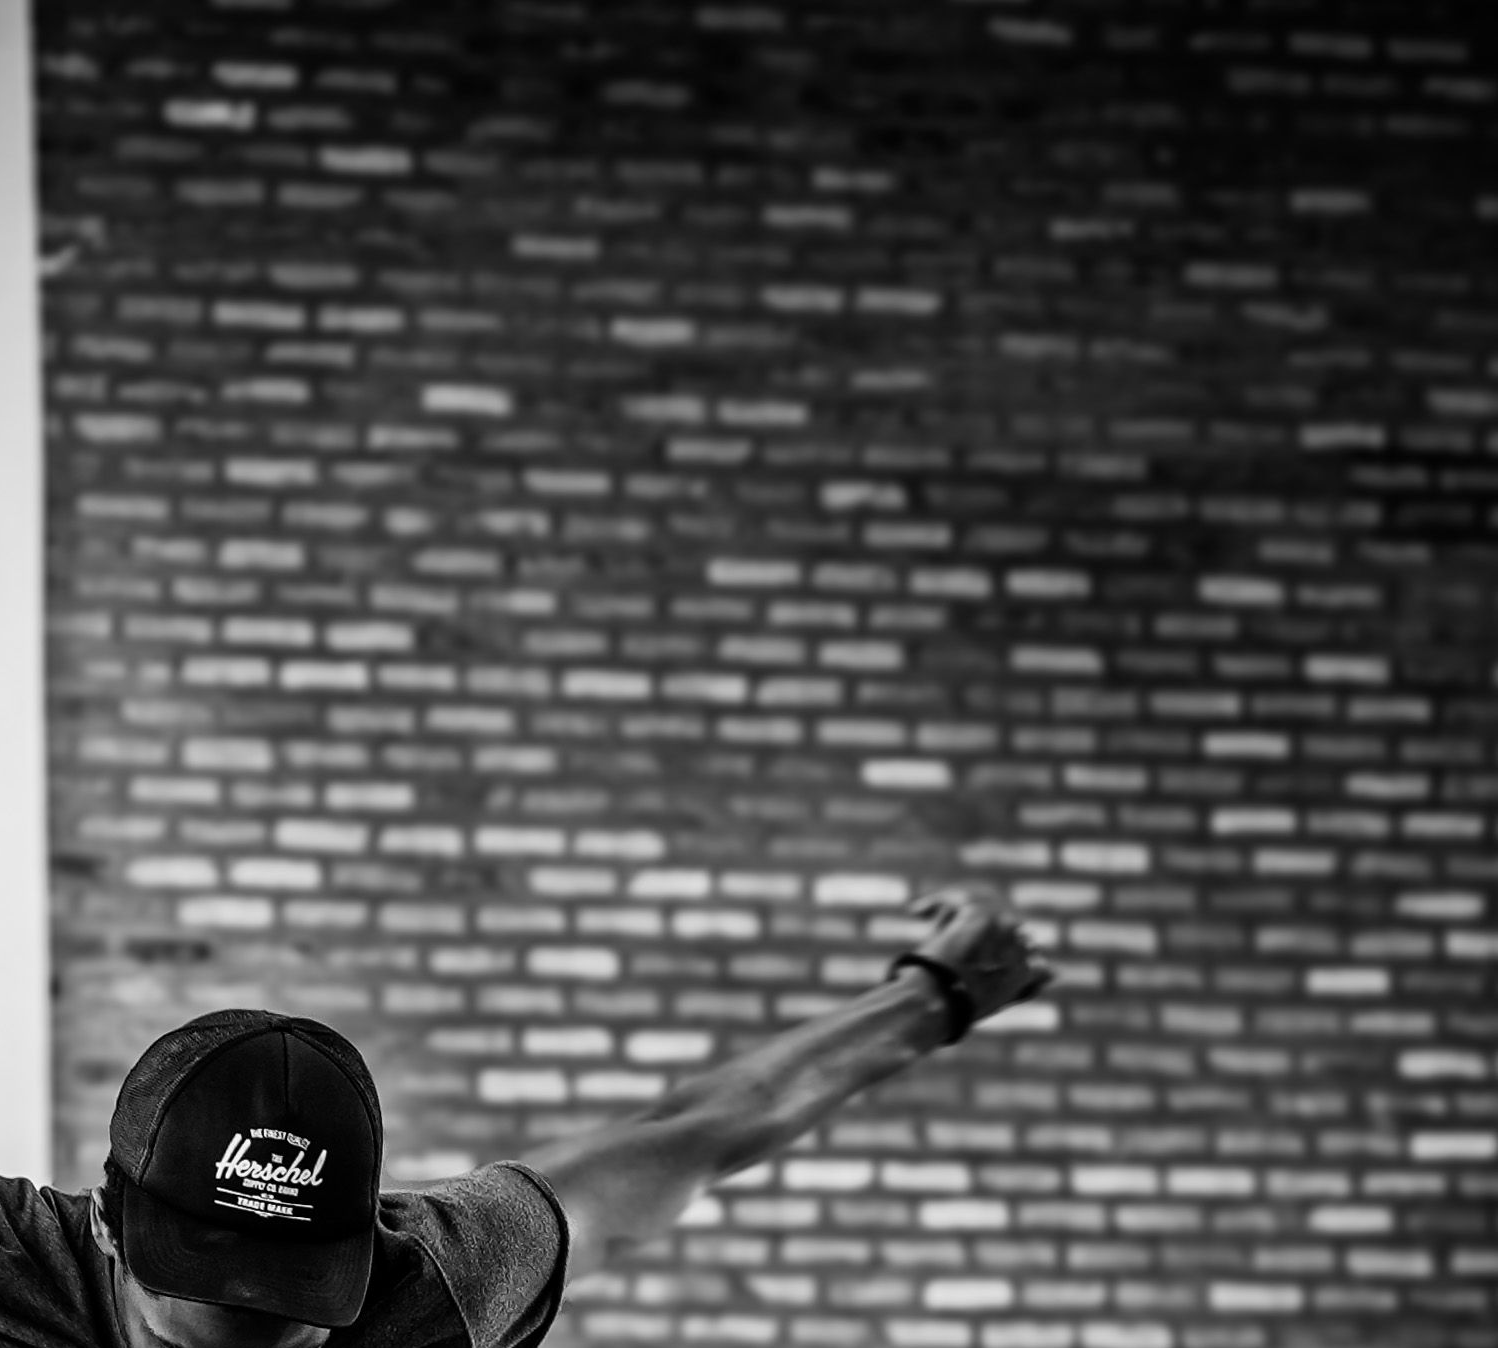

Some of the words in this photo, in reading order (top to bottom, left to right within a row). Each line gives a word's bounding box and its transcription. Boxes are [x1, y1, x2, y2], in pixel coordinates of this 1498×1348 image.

[215, 1133, 327, 1186] Herschel
[237, 1196, 265, 1211] TRADE
[267, 1203, 293, 1216] MARK
